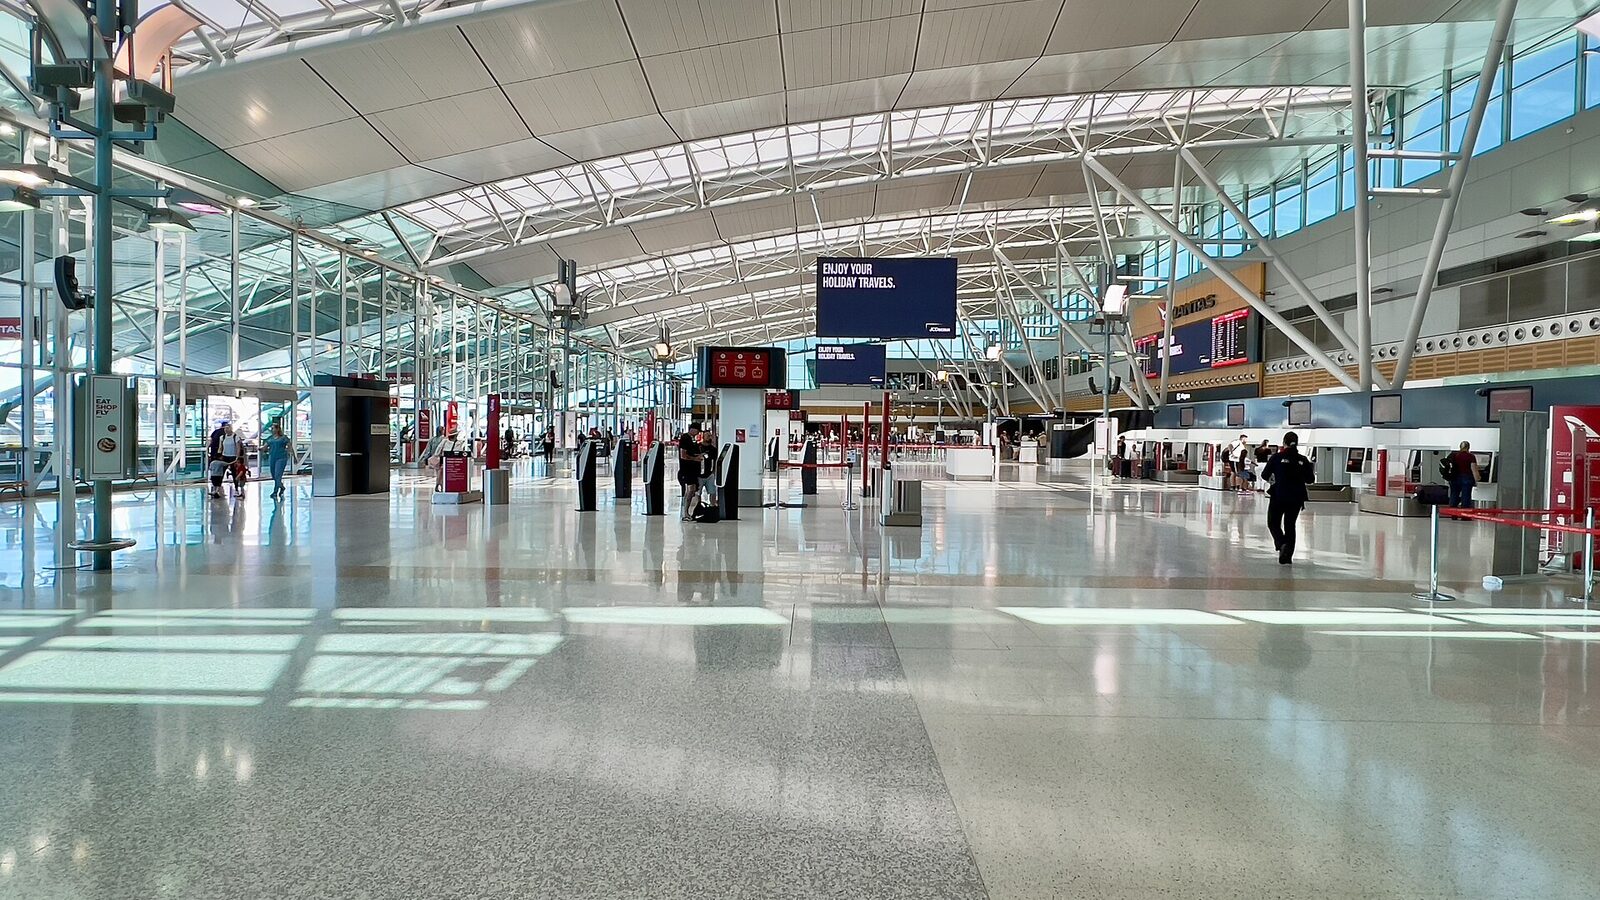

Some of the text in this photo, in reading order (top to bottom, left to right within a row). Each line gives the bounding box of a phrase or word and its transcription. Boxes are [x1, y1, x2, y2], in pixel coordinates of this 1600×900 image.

[822, 262, 873, 275] ENJOY YOUR
[822, 276, 896, 289] HOLIDAY TRAVELS.
